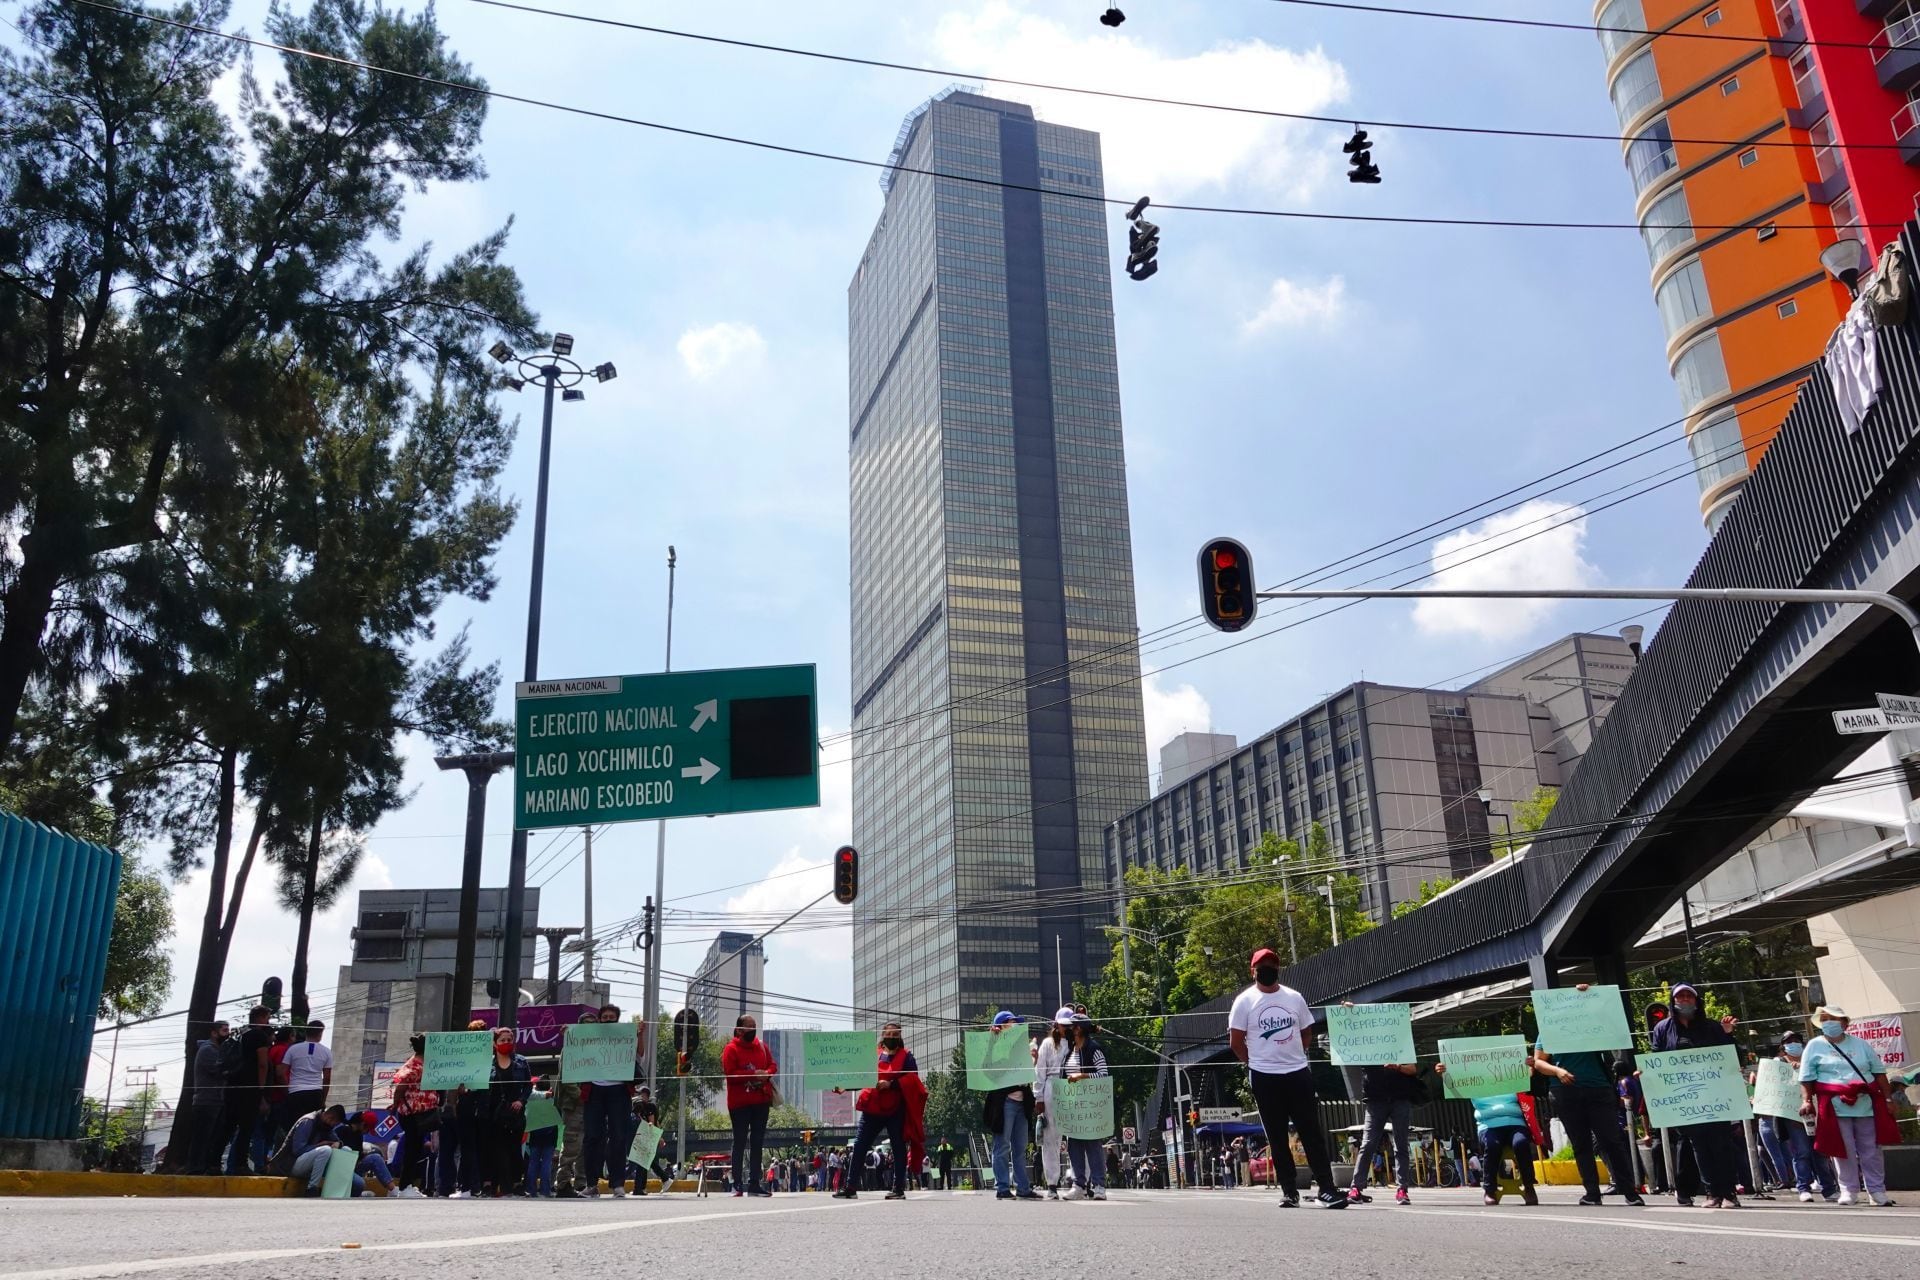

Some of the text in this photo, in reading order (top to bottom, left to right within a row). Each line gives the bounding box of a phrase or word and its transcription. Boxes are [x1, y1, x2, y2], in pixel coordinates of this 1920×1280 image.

[528, 680, 608, 694] MARINA NACIONAL
[530, 705, 678, 738] EJERCITO NACIONAL
[1842, 714, 1880, 728] MARINA
[526, 745, 673, 778] LAGO XOCHIMILCO
[525, 779, 673, 814] MARIANO ESCOBEDO
[1330, 1003, 1409, 1018] NO QUEREMOS
[429, 1033, 491, 1045] NO QUEREMOS
[1644, 1051, 1725, 1069] NO QUEREMOS
[1883, 1052, 1904, 1063] 4391
[1651, 1091, 1700, 1108] QUEREMOS
